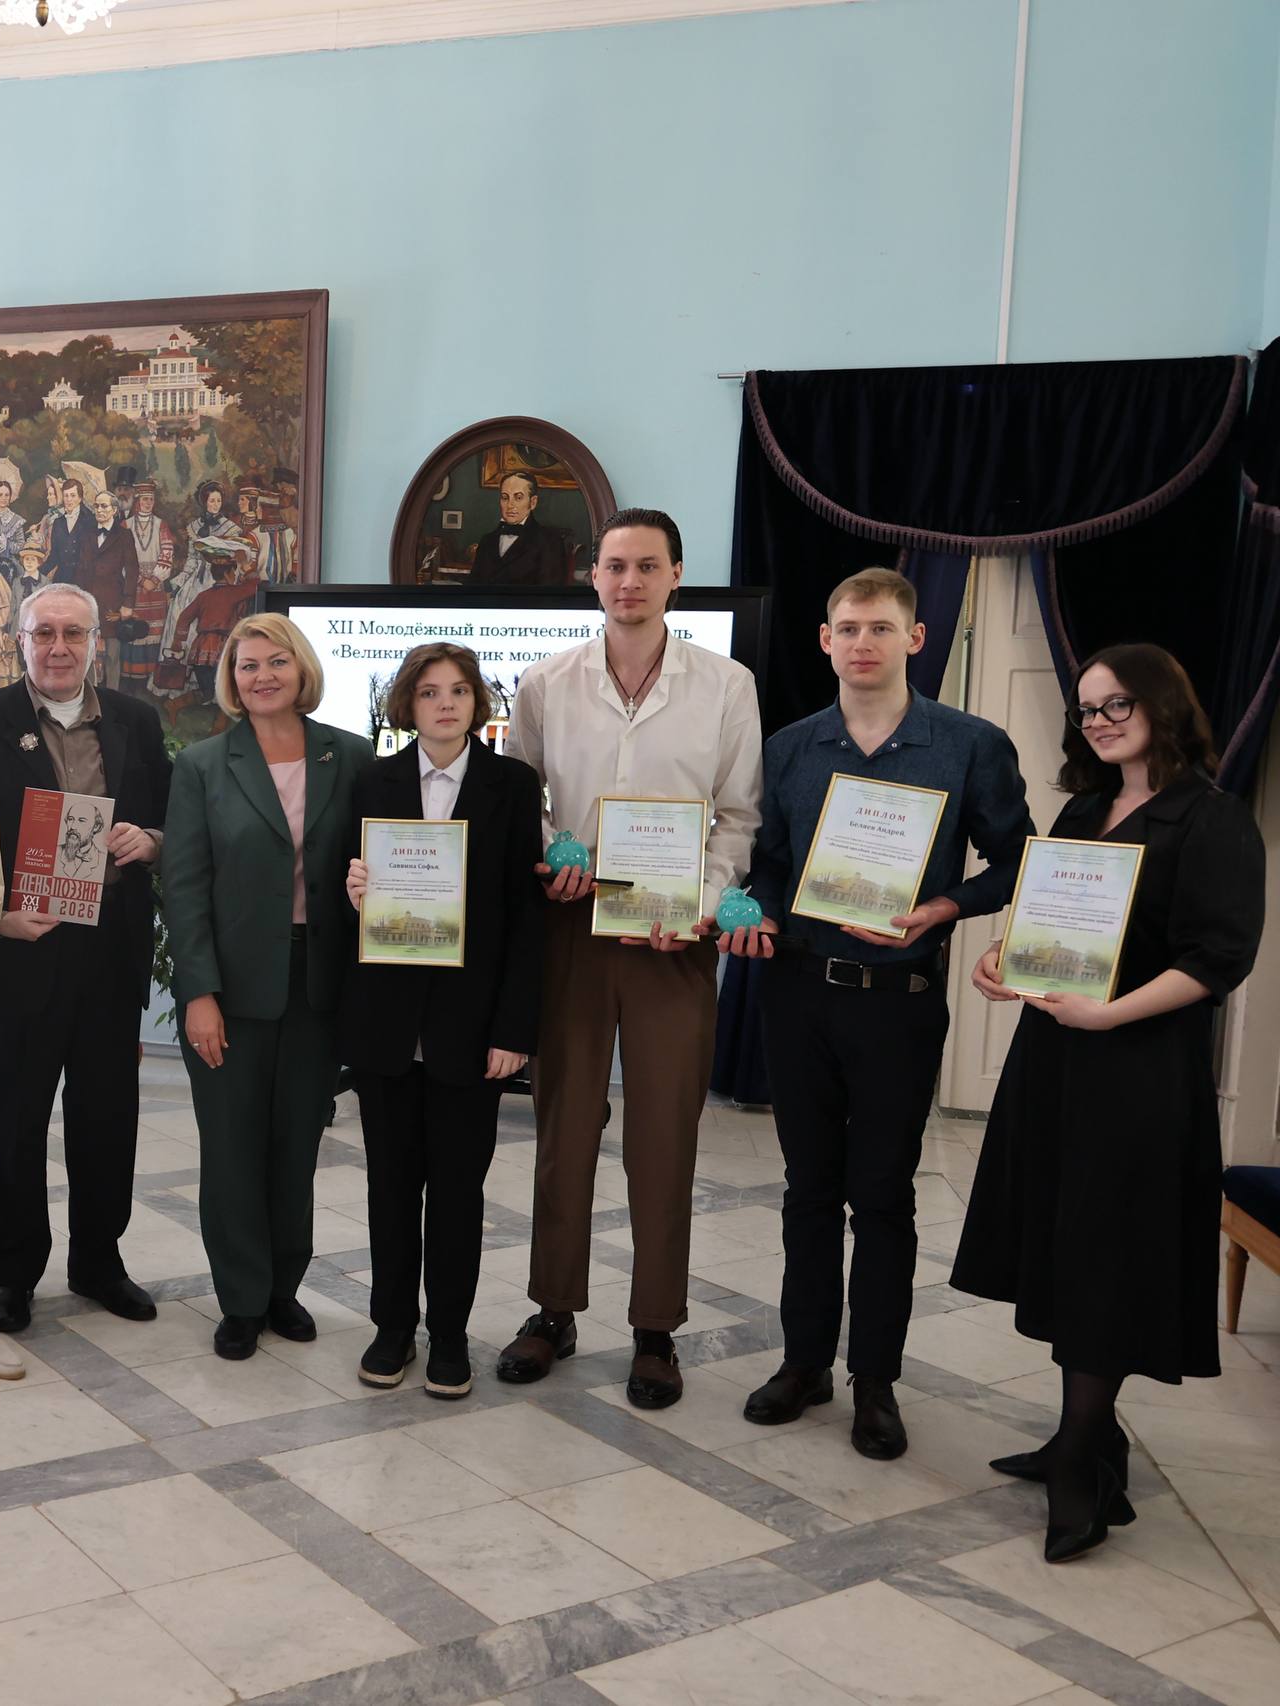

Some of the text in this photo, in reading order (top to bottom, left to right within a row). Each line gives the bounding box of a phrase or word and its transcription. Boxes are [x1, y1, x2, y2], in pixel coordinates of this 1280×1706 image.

[327, 620, 353, 635] XII
[359, 621, 474, 637] Молодёжный
[480, 624, 591, 638] поэтический
[855, 807, 906, 822] ДИПЛОМ
[628, 825, 675, 834] ДИПЛОМ
[392, 848, 437, 856] ДИПЛОМ
[1051, 870, 1103, 882] ДИПЛОМ
[20, 873, 98, 902] ДЕНЬ ПОЭЗИИ
[22, 894, 40, 905] XXI
[60, 901, 94, 918] 2026
